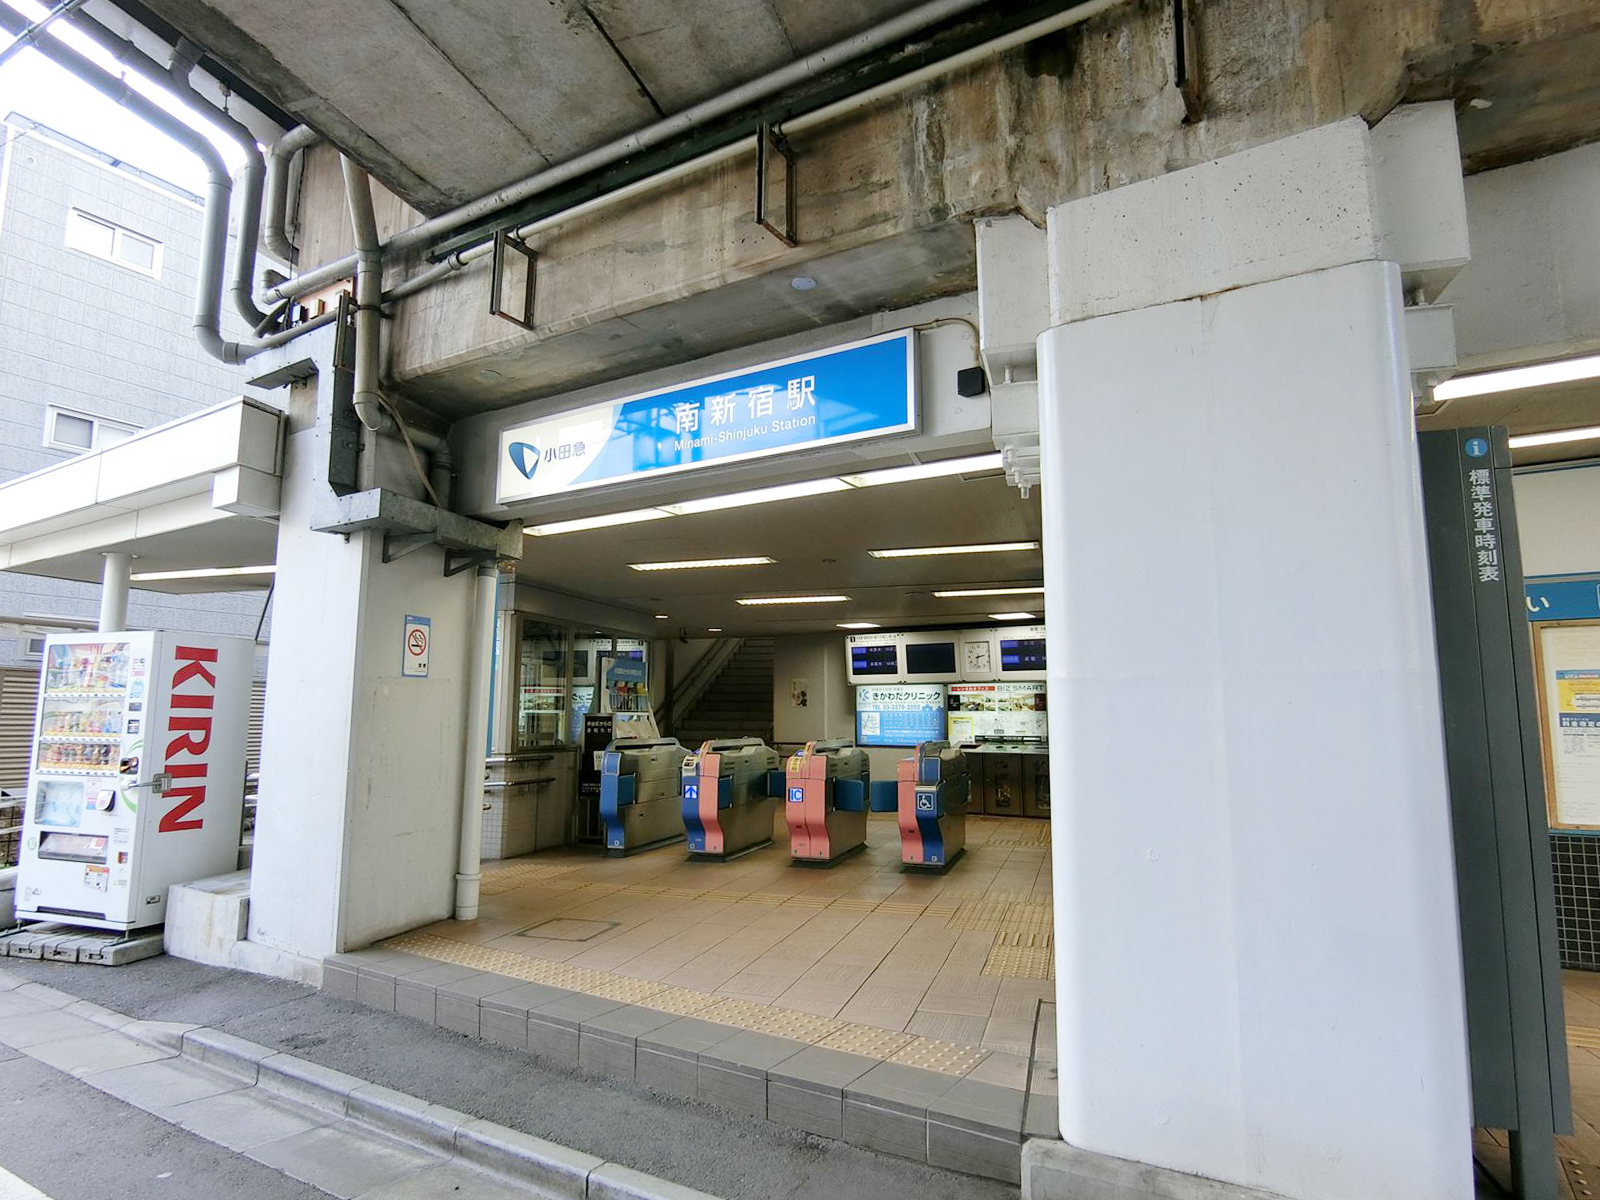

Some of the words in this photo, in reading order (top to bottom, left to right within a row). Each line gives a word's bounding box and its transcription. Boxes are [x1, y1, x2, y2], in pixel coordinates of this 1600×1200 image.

[674, 375, 816, 434] 南新宿駅
[674, 421, 768, 451] Minami-Shinjuku
[772, 415, 816, 432] Station
[544, 441, 586, 462] 小田急
[1469, 468, 1500, 582] 標準発車時刻表
[873, 692, 940, 701] きかわだクリニック
[158, 645, 219, 833] KIRIN
[791, 789, 802, 801] IC
